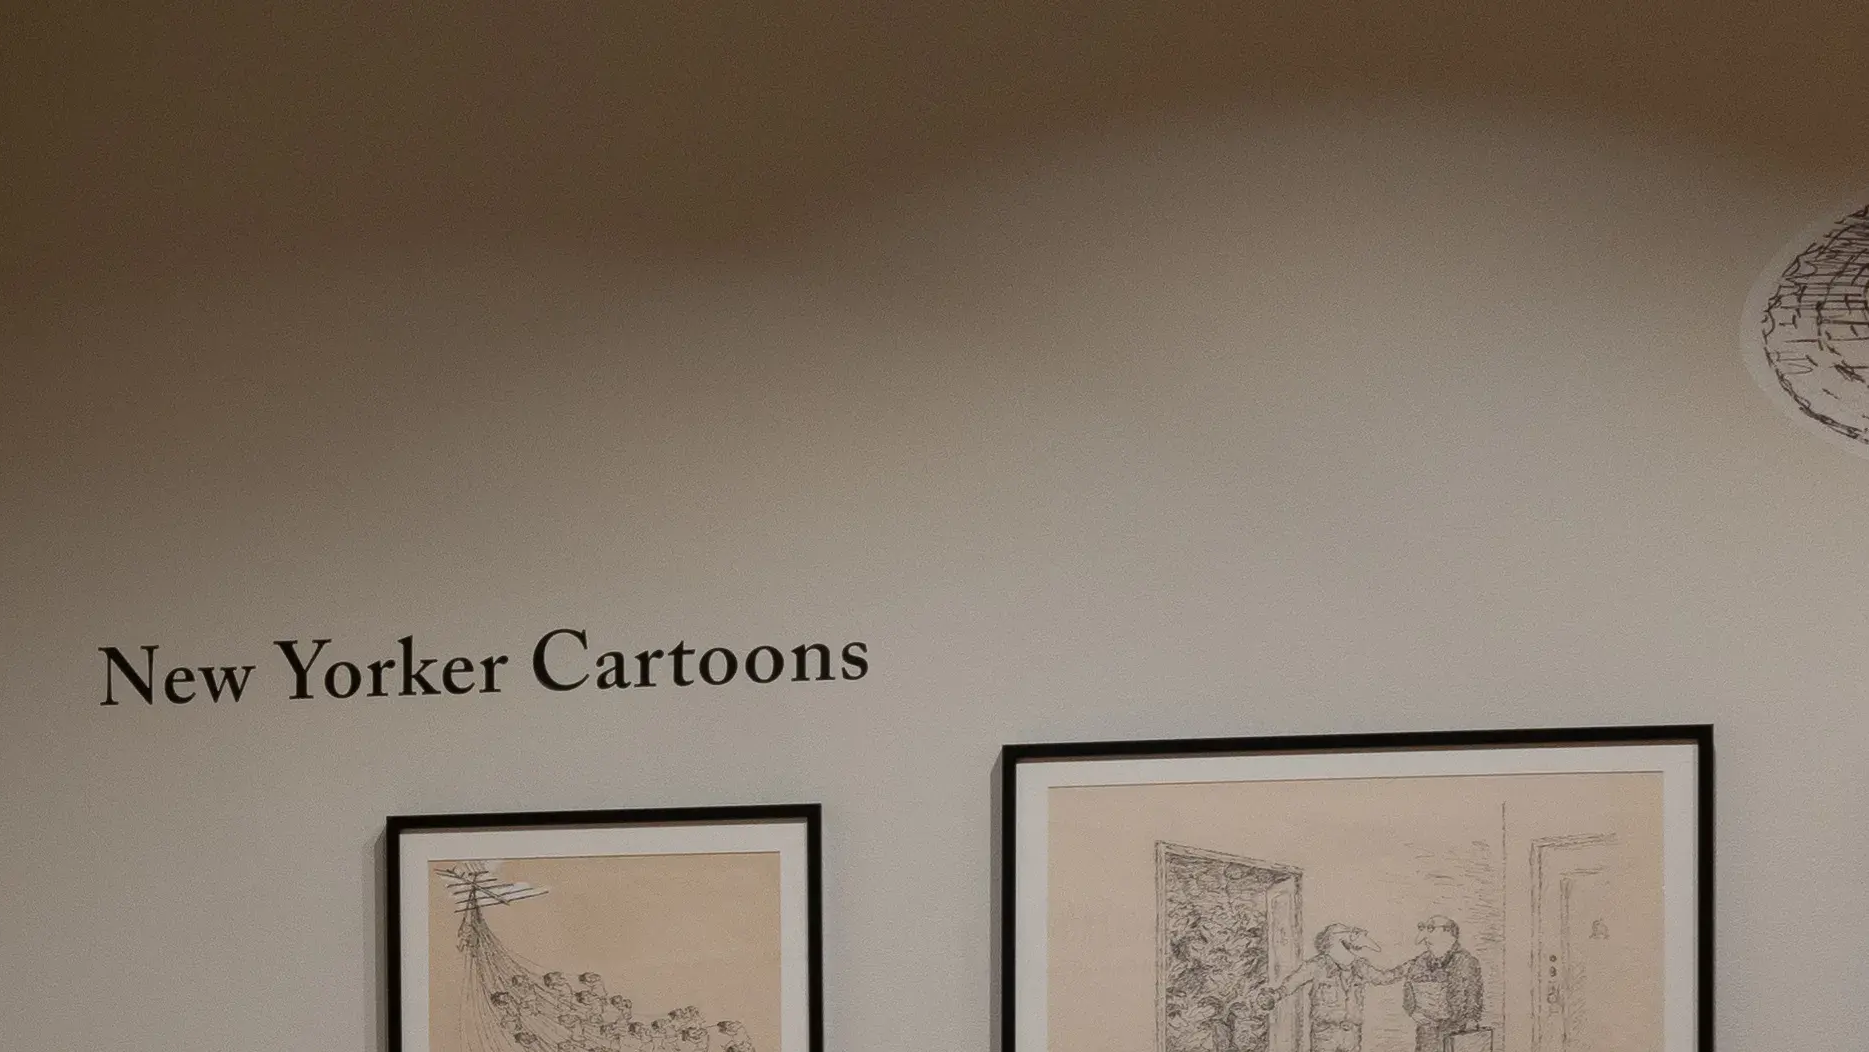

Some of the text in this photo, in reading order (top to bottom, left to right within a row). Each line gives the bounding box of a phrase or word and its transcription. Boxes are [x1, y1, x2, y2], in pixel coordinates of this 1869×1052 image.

[98, 628, 869, 706] New Yorker Cartoons
